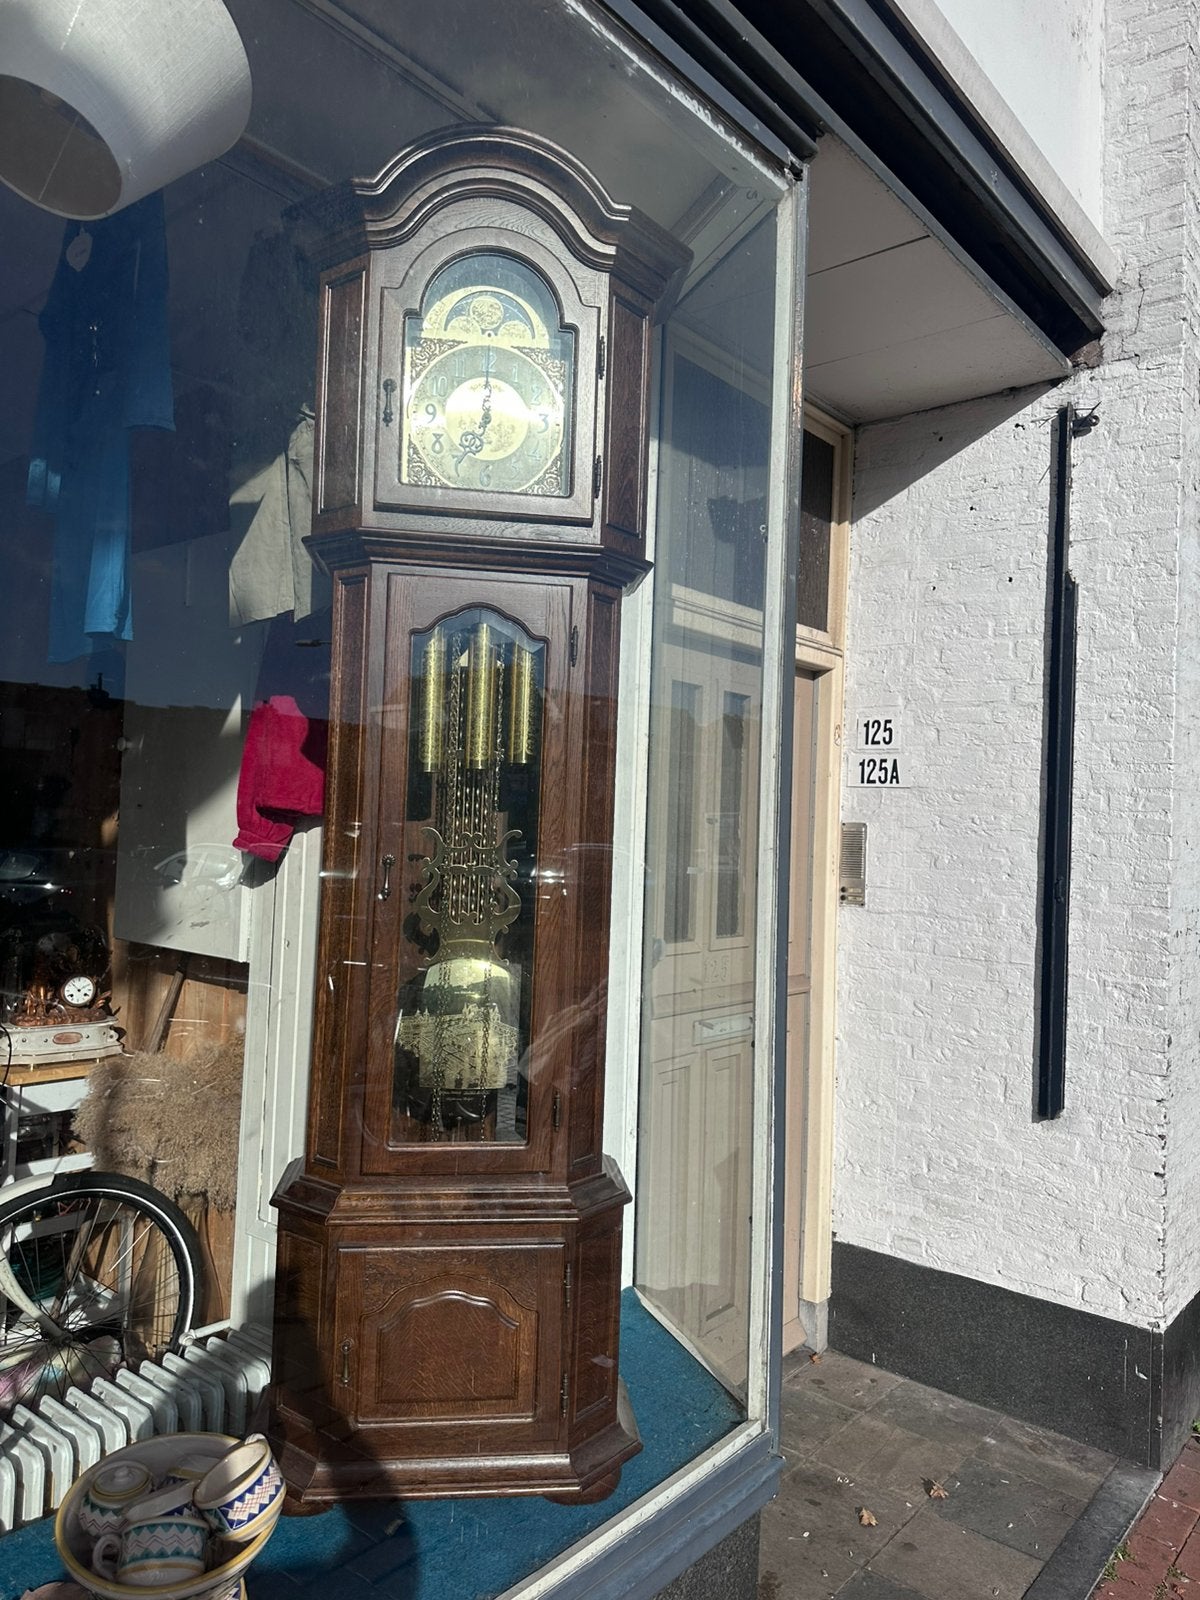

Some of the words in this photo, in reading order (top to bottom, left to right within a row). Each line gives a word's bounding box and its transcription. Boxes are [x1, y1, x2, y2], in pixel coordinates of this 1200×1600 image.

[454, 358, 467, 378] 11
[481, 351, 497, 374] 12
[512, 364, 519, 383] 1
[432, 375, 449, 397] 10
[530, 386, 542, 406] 2
[425, 403, 437, 424] 9
[538, 413, 549, 434] 3
[431, 433, 444, 454] 8
[479, 464, 491, 487] 6
[864, 719, 893, 745] 125
[859, 759, 900, 784] 125A
[704, 956, 729, 984] 125
